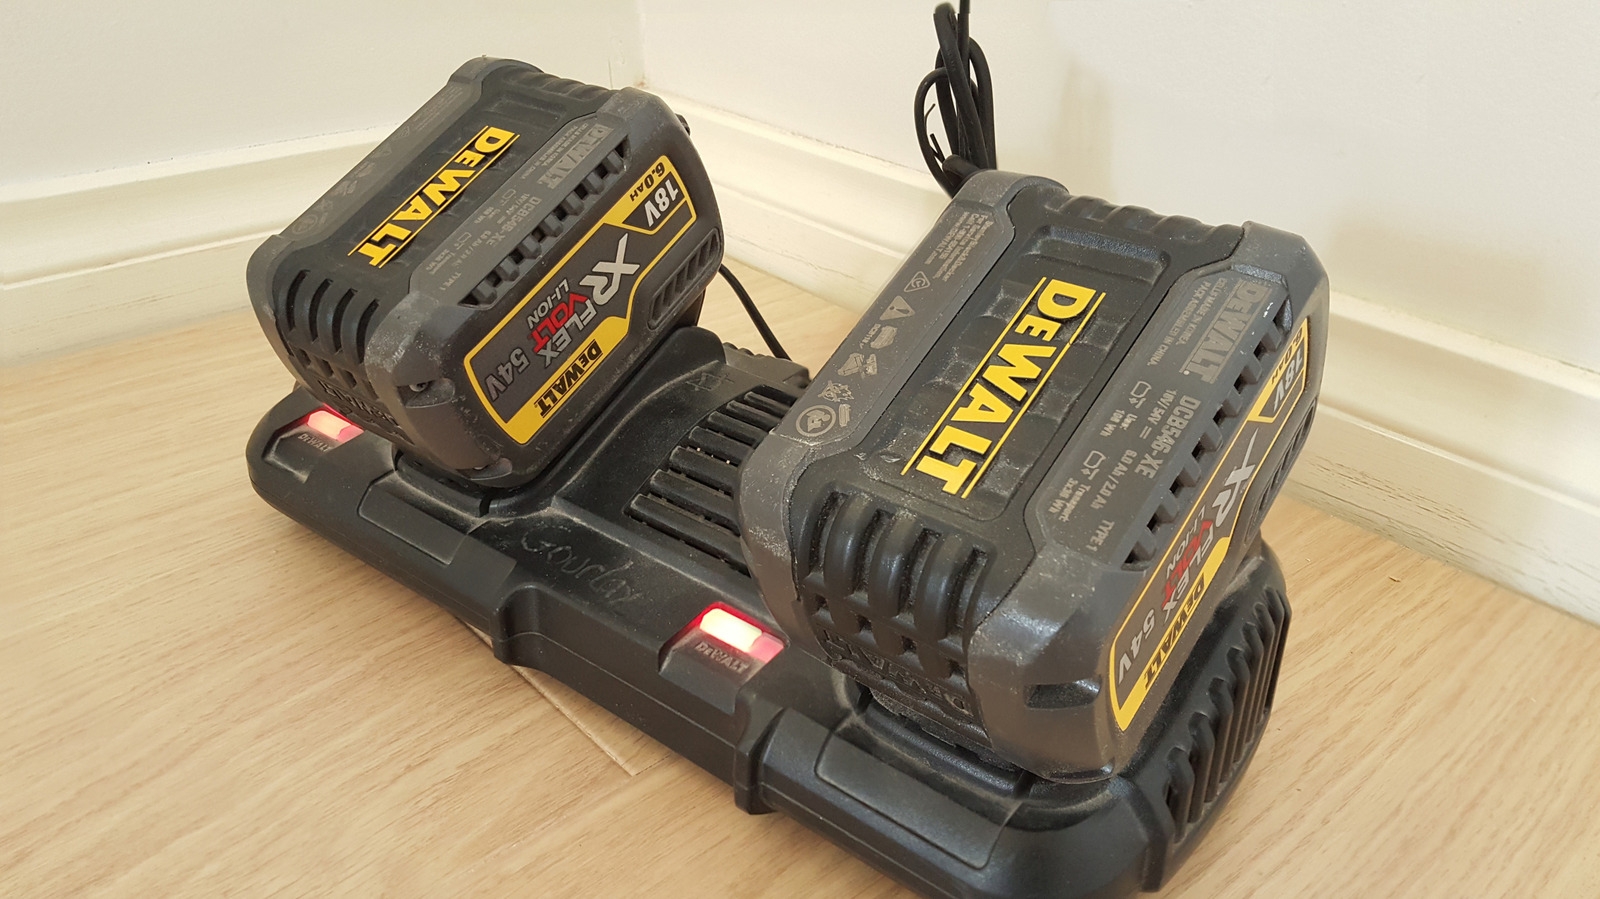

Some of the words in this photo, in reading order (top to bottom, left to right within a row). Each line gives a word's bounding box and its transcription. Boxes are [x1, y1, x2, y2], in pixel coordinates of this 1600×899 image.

[537, 123, 613, 189] DEWALT
[357, 127, 514, 267] DEWALT
[642, 177, 678, 226] 18V
[578, 233, 640, 306] XR
[1192, 280, 1211, 299] PACK
[526, 277, 569, 329] LI-ION
[528, 293, 587, 352] VOLT
[1168, 297, 1199, 336] ASSEMBLED
[1182, 280, 1268, 383] DEWALT
[1196, 294, 1215, 316] MADE
[537, 299, 596, 367] FLEX
[1146, 344, 1168, 367] CHINA.
[483, 346, 528, 400] 54V
[534, 340, 602, 416] DEWALT
[914, 279, 1096, 495] DEWALT
[1274, 348, 1305, 411] 18V
[1099, 424, 1116, 437] Wh
[1120, 449, 1137, 465] 6.0
[1133, 394, 1201, 479] DCB546-XE
[1098, 480, 1116, 497] 2.0
[1110, 462, 1127, 478] Ah
[1211, 426, 1257, 528] XR
[1047, 499, 1064, 514] Wh
[1089, 494, 1106, 510] Ah
[1089, 519, 1114, 546] TYPE
[1164, 503, 1205, 578] LI-ION
[1159, 520, 1212, 608] VOLT
[1163, 522, 1216, 622] FLEX
[695, 641, 748, 674] DEWALT
[1118, 608, 1158, 684] 54V
[1143, 572, 1207, 688] DEWALT
